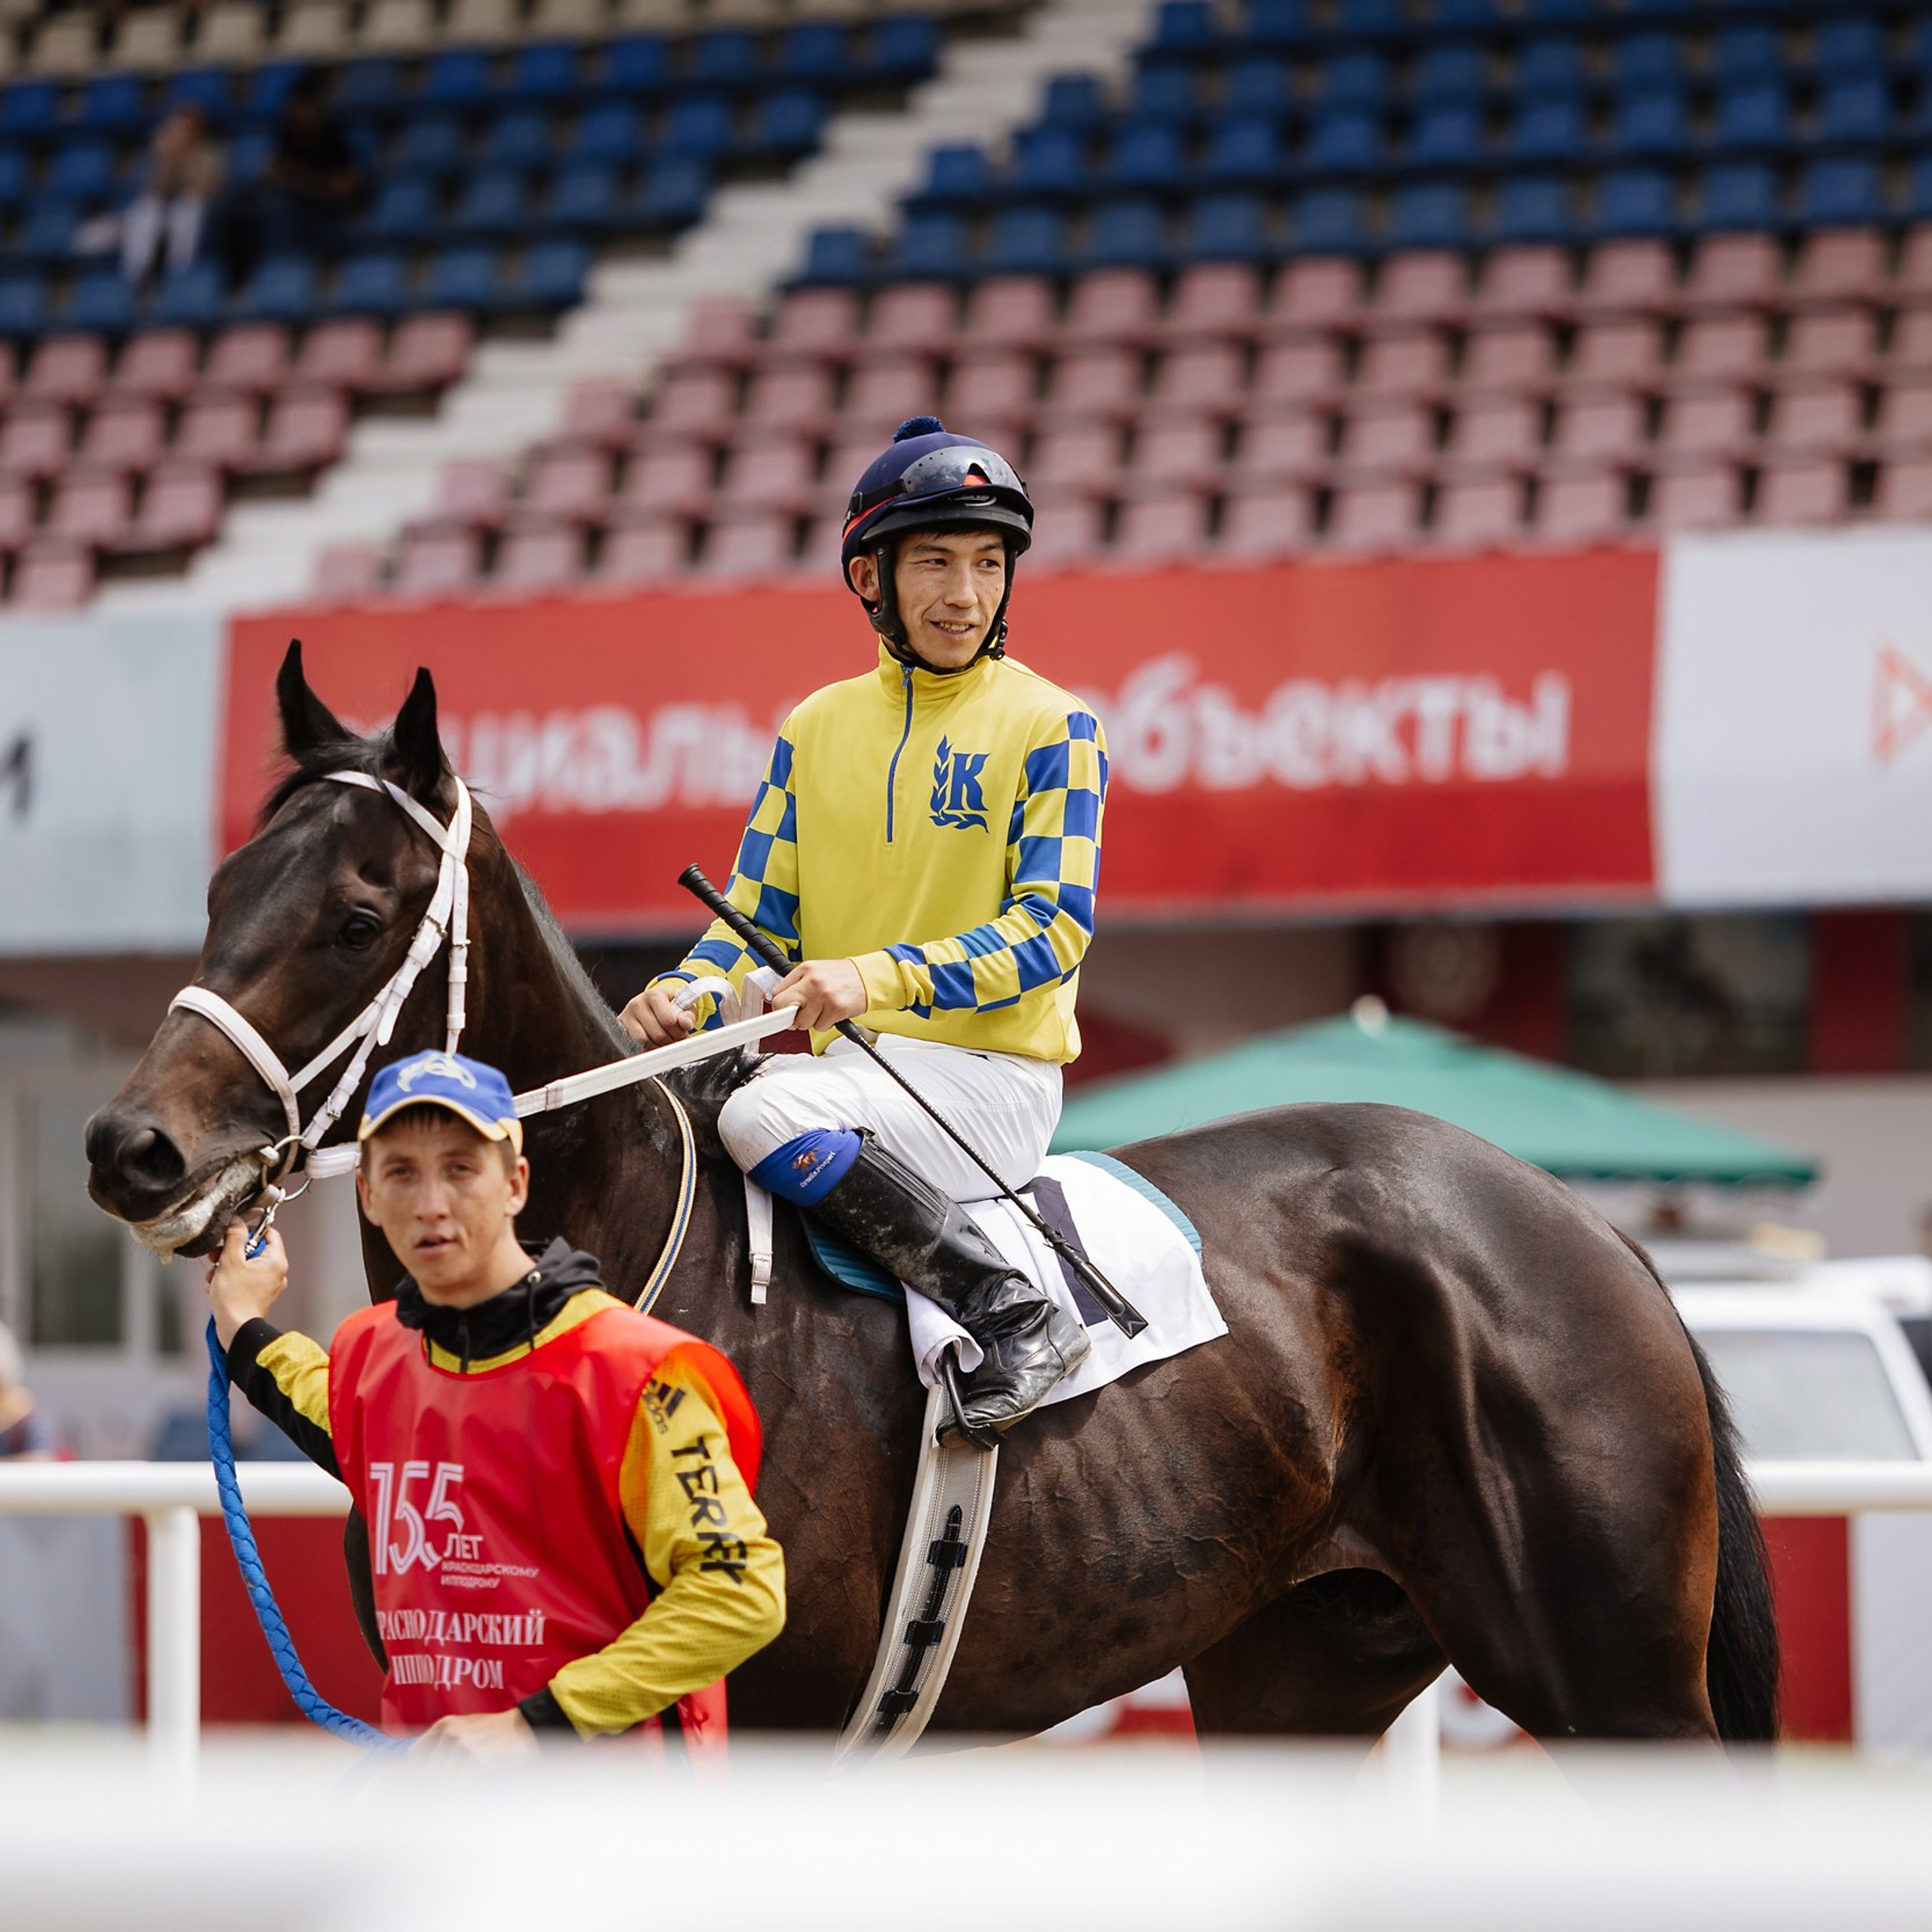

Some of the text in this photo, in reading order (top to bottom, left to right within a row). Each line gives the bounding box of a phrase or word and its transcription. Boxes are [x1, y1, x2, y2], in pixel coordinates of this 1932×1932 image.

[369, 1460, 484, 1575] 155 ЛЕТ
[441, 1560, 539, 1578] КРАСНОДАРСКОМУ
[441, 1574, 500, 1589] ИППОДРОМУ
[376, 1608, 546, 1647] РАСНОДАРСКИЙ
